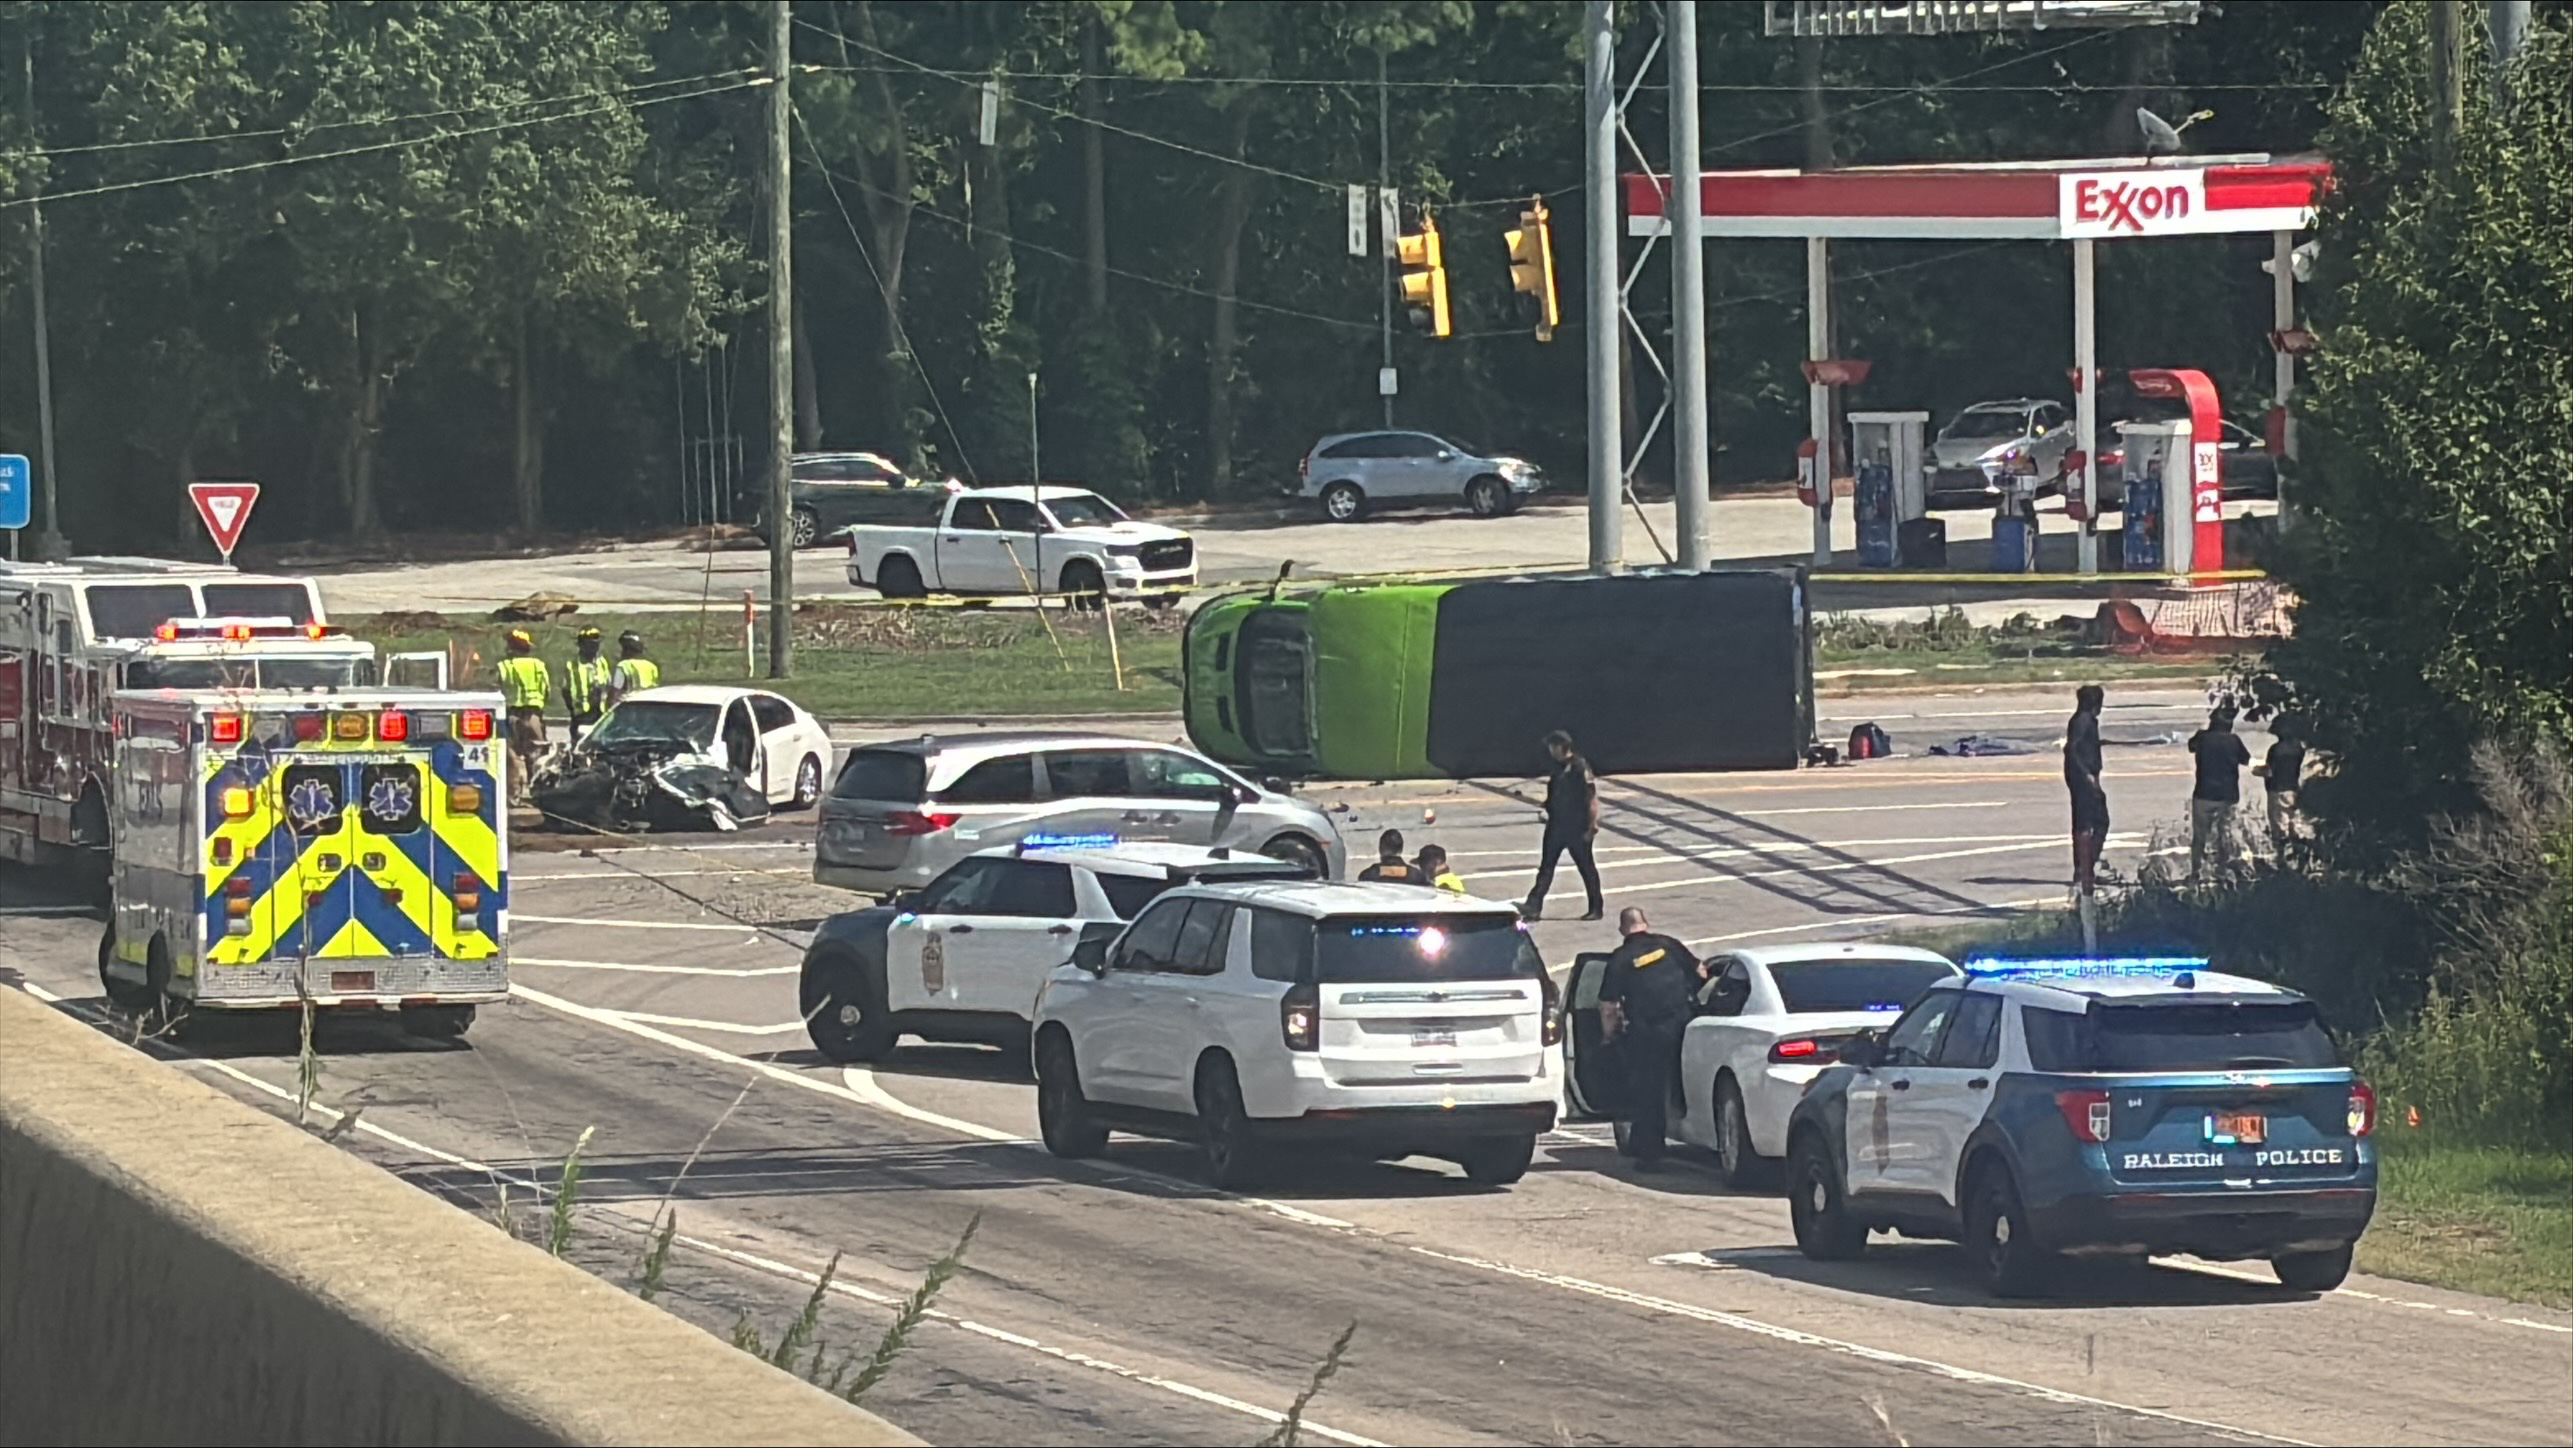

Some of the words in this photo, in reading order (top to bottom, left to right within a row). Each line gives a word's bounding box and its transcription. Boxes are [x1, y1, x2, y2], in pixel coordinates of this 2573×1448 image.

[2076, 180, 2189, 231] Exxon
[2124, 1153, 2224, 1169] RALEIGH
[2256, 1149, 2343, 1166] POLICE
